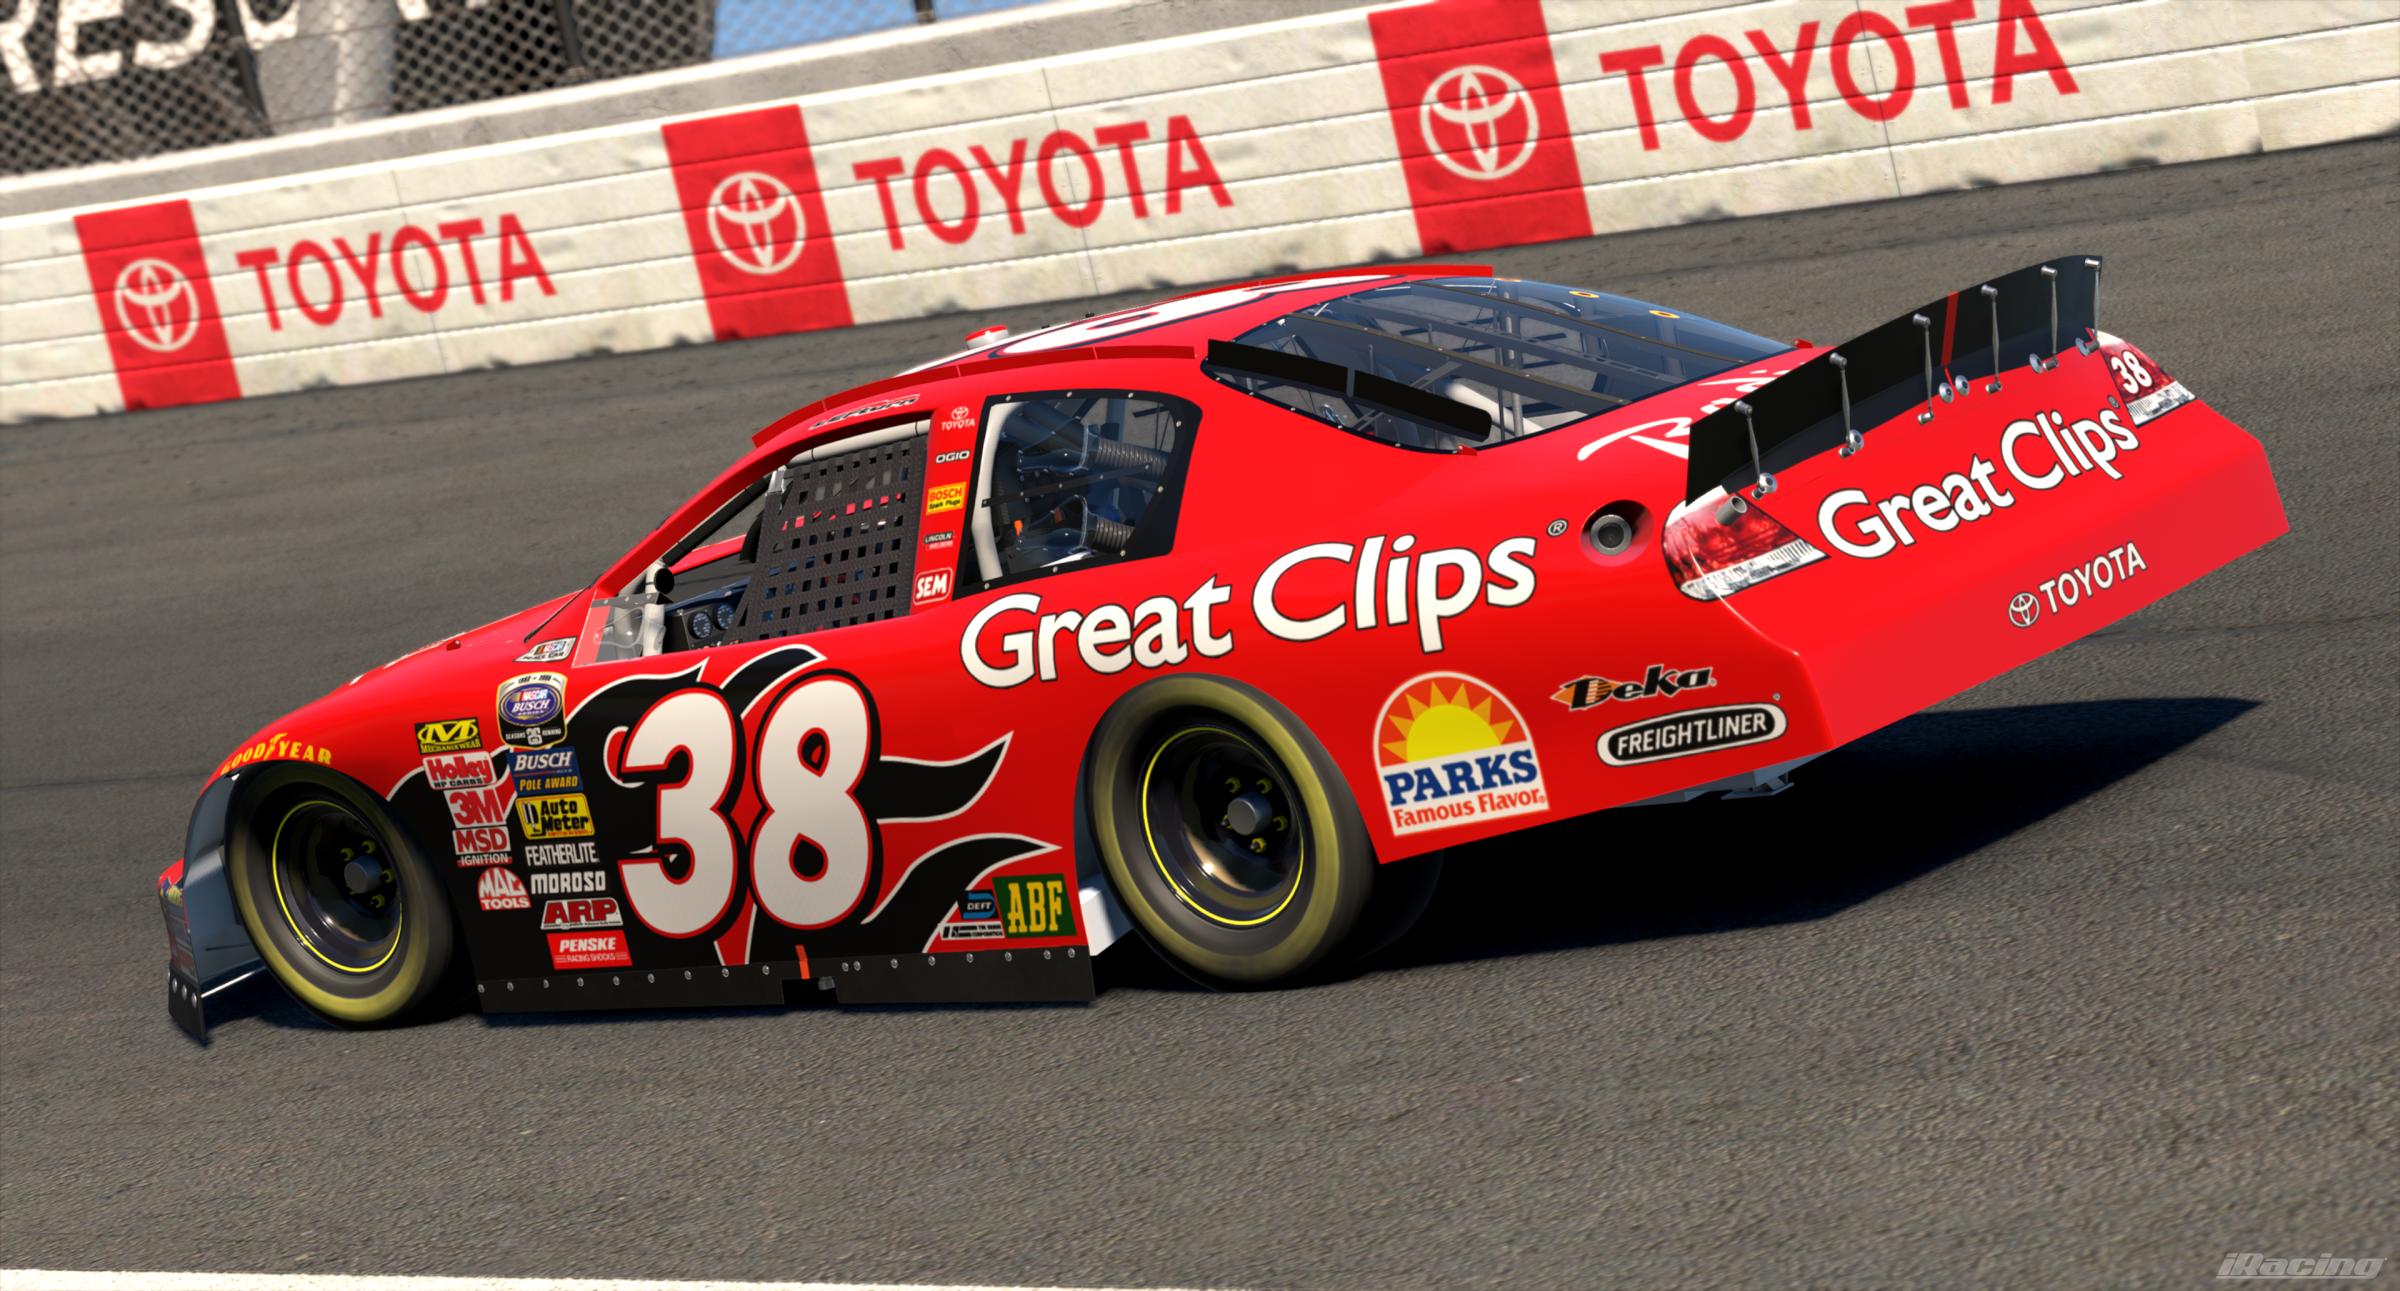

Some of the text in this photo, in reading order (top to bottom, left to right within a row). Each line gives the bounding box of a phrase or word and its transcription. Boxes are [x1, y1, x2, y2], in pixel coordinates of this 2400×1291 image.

[1600, 0, 2080, 152] TOYOTA
[852, 114, 1234, 251] TOYOTA
[236, 213, 557, 331] TOYOTA
[2110, 350, 2153, 394] 38
[941, 419, 975, 431] TOYOTA
[935, 450, 970, 464] OGIO
[929, 488, 962, 502] BOSCH
[1817, 408, 2141, 559] Great Clips
[925, 532, 953, 544] LINCOLN
[916, 573, 947, 599] SEM
[2038, 540, 2149, 614] TOYOTA
[959, 533, 1538, 688] Great Clips
[512, 699, 551, 713] BUSCH
[521, 689, 548, 702] NASCAR
[421, 738, 481, 753] MECHANIX WEAR
[1617, 712, 1768, 757] FREIGHTLINER
[426, 755, 493, 784] Holley
[514, 751, 574, 771] BUSCH
[519, 776, 578, 791] POLE AWARD
[1384, 749, 1538, 807] PARKS
[450, 788, 503, 826] 3M
[541, 799, 578, 816] Auto
[616, 674, 874, 940] 38
[1393, 800, 1476, 829] Famous
[541, 815, 590, 834] Meter
[455, 827, 509, 853] MSD
[461, 853, 510, 866] IGNITION
[525, 842, 597, 867] FEATHERLITE
[478, 867, 527, 898] MAC
[531, 871, 606, 895] MOROSO
[481, 897, 531, 910] TOOLS
[543, 898, 617, 925] ARP
[966, 902, 993, 911] DEFT
[1007, 880, 1063, 934] ABF
[559, 937, 618, 953] PENSKE
